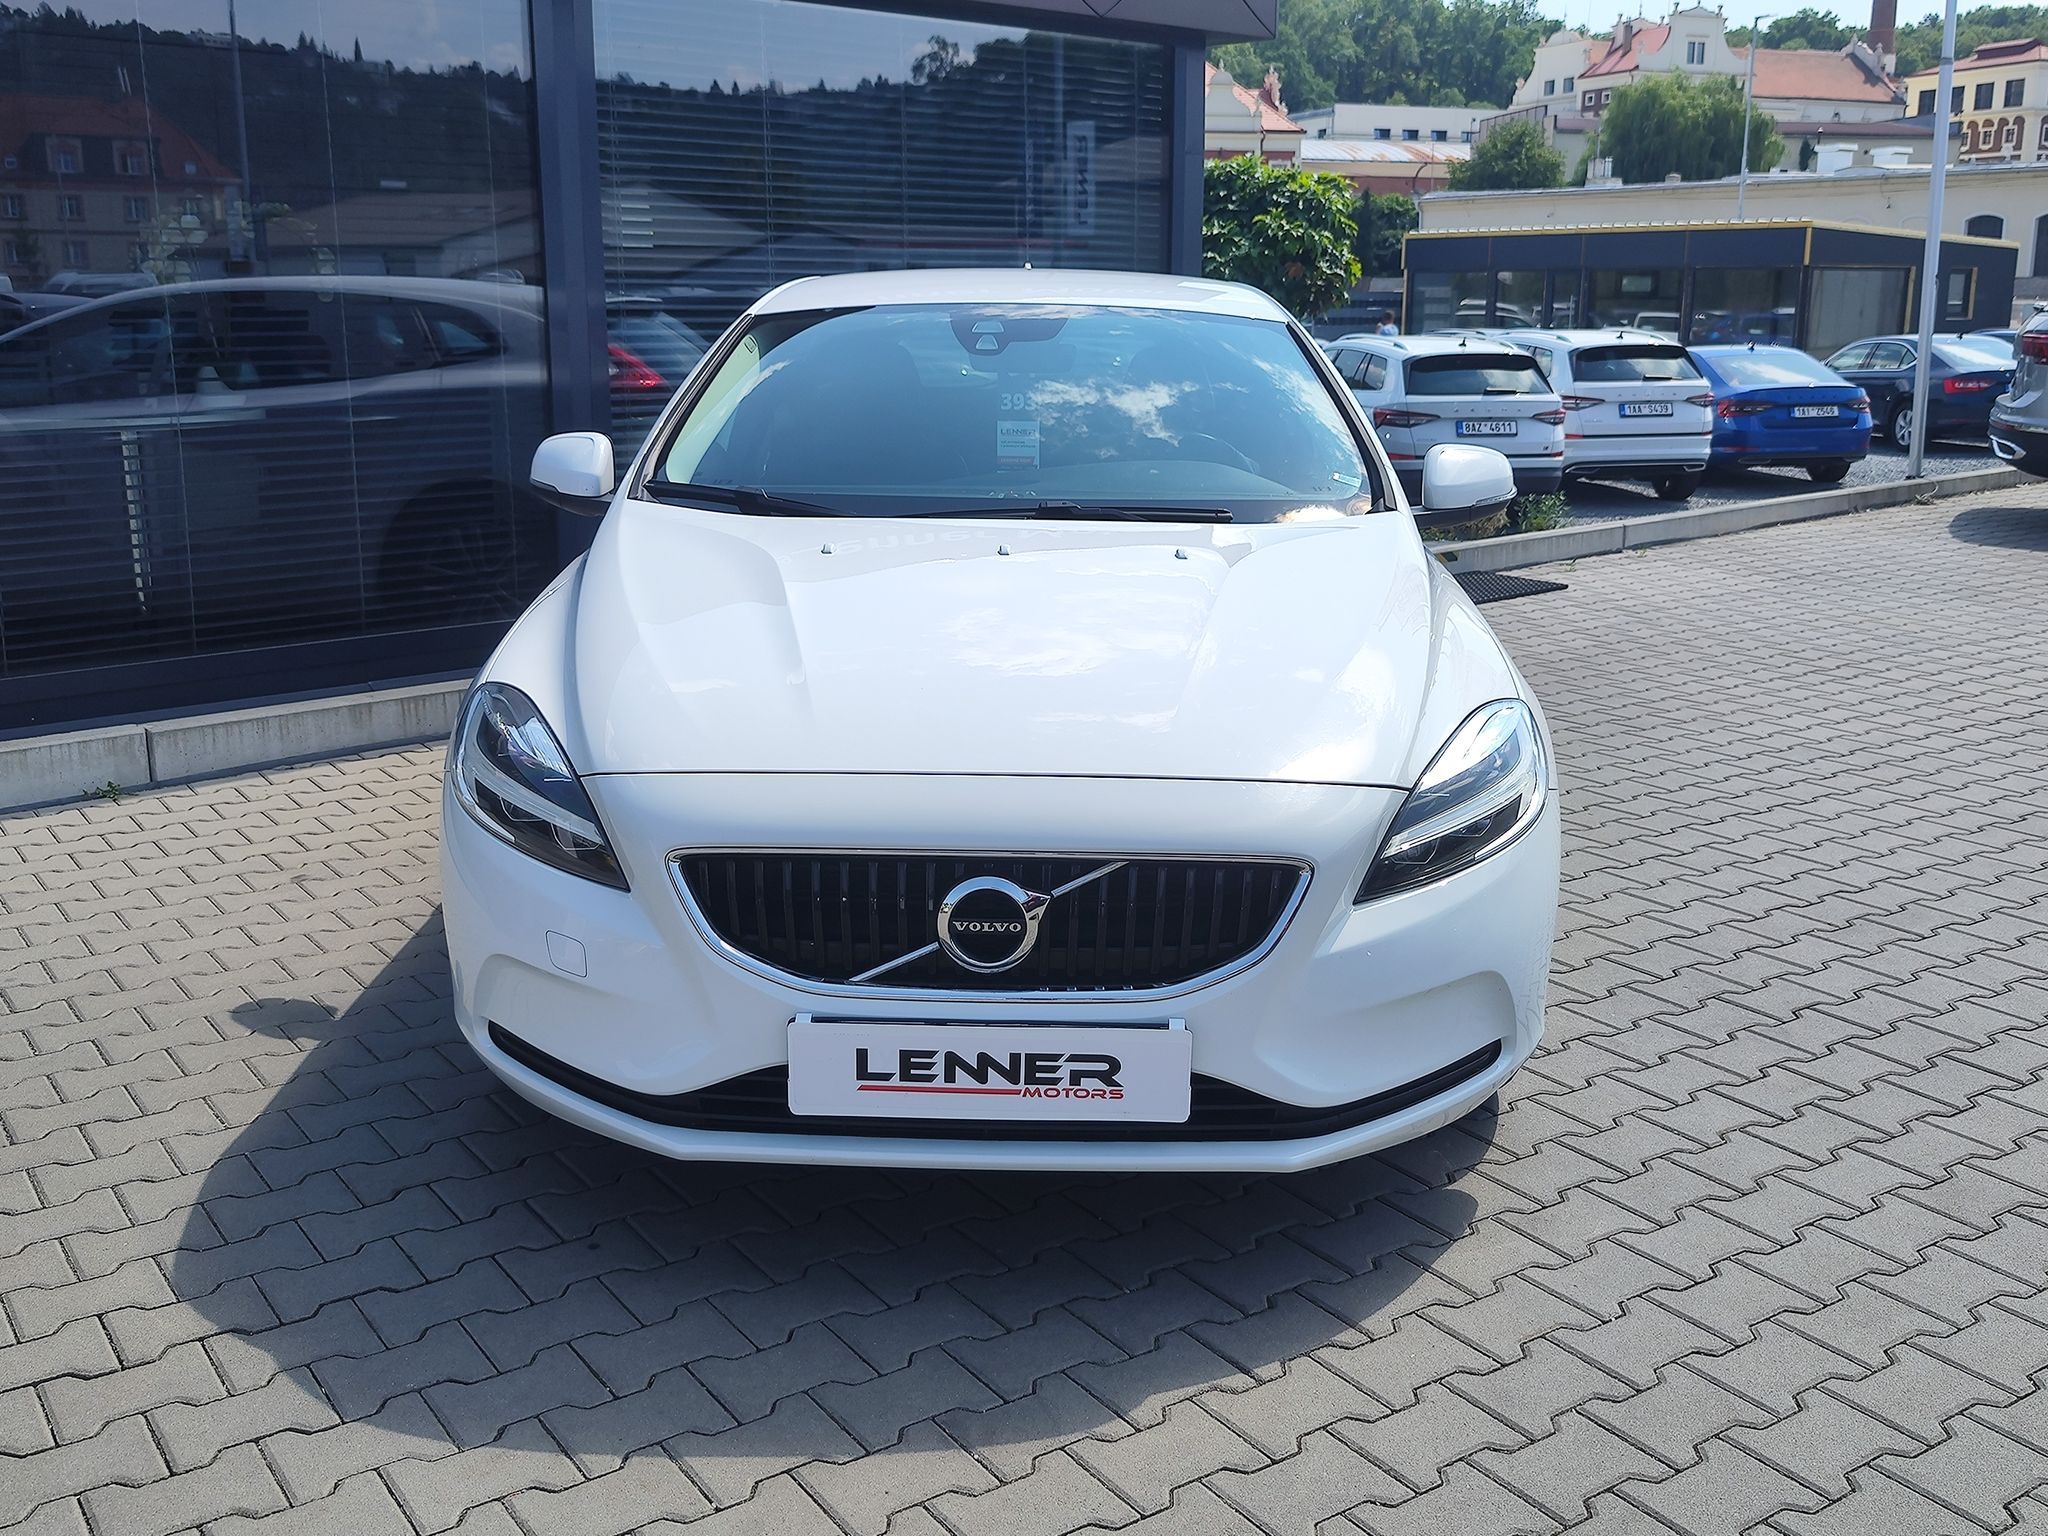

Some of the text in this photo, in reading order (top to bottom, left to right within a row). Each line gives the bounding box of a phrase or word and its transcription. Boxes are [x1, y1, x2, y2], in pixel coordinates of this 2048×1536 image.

[1464, 422, 1512, 433] 8AZ 4611
[952, 921, 1022, 933] VOLVO
[855, 1047, 1125, 1088] LENNER
[1021, 1086, 1125, 1100] MOTORS
